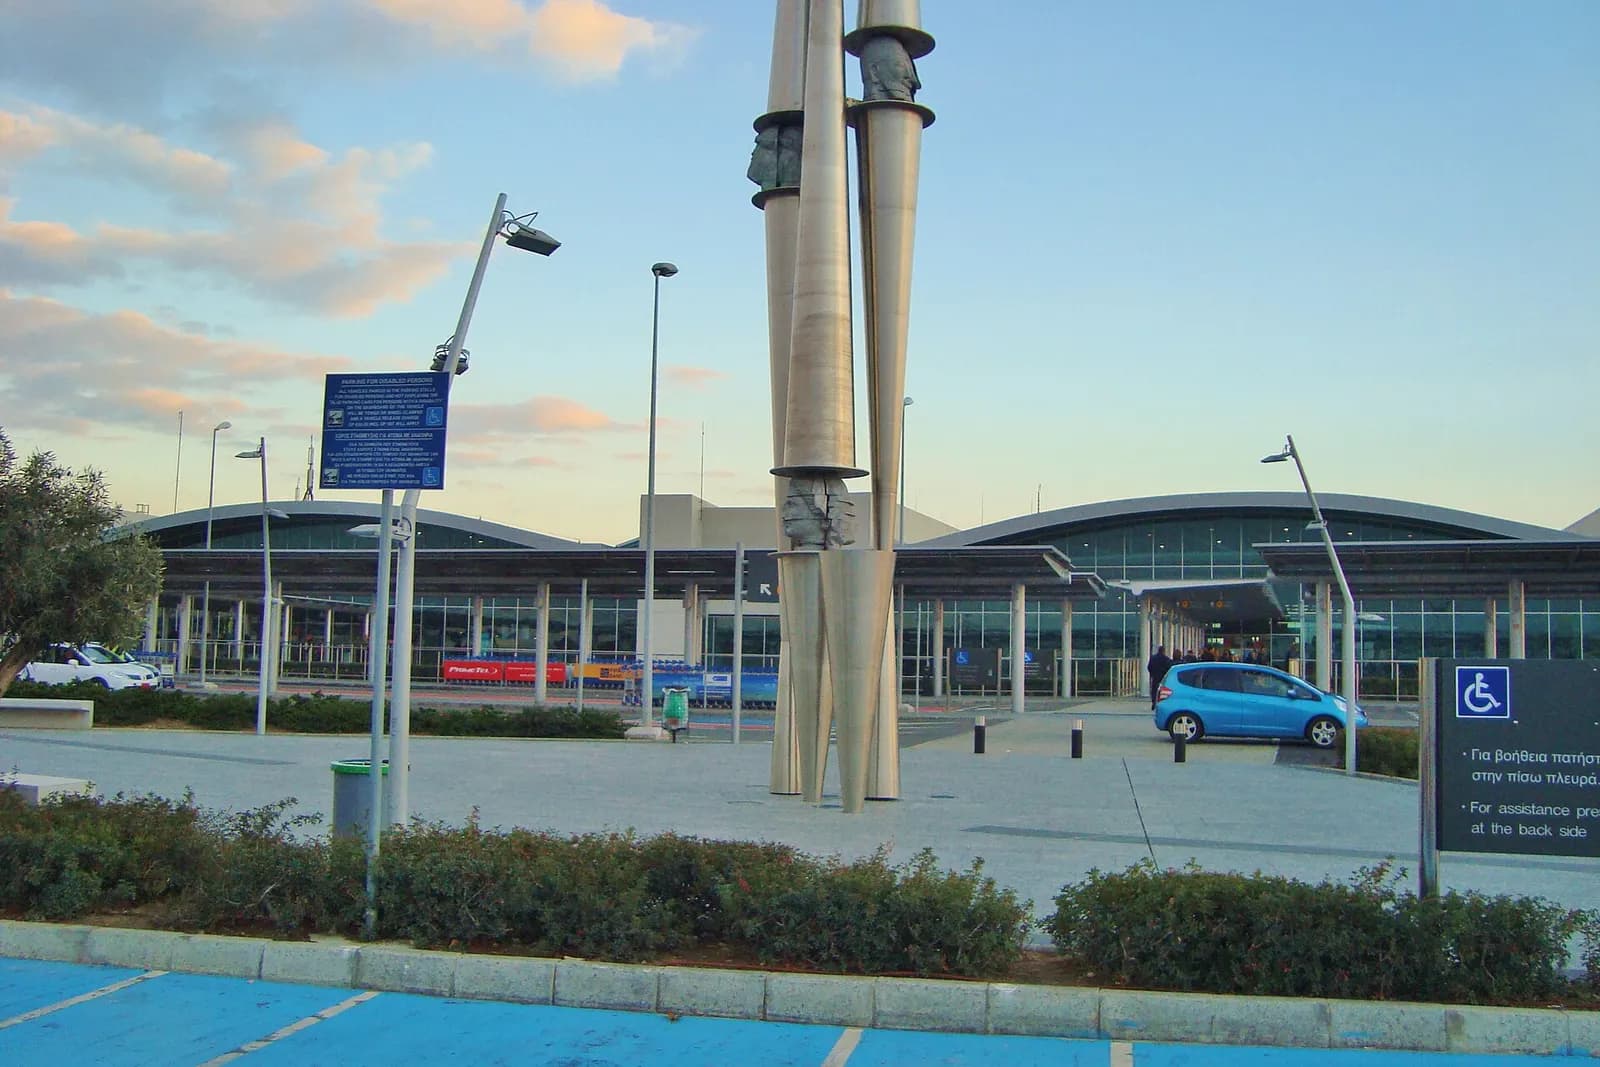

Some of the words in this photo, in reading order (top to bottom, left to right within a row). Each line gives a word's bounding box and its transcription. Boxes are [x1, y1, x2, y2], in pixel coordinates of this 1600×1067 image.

[1471, 748, 1491, 760] Για
[1495, 749, 1548, 764] βοήθεια
[1472, 772, 1502, 784] στην
[1507, 770, 1542, 783] πίσω
[1470, 802, 1492, 814] For
[1498, 803, 1570, 816] assistance
[1576, 807, 1600, 820] pre
[1471, 822, 1485, 834] at
[1492, 822, 1512, 834] the
[1519, 824, 1552, 836] back
[1560, 825, 1587, 838] side
